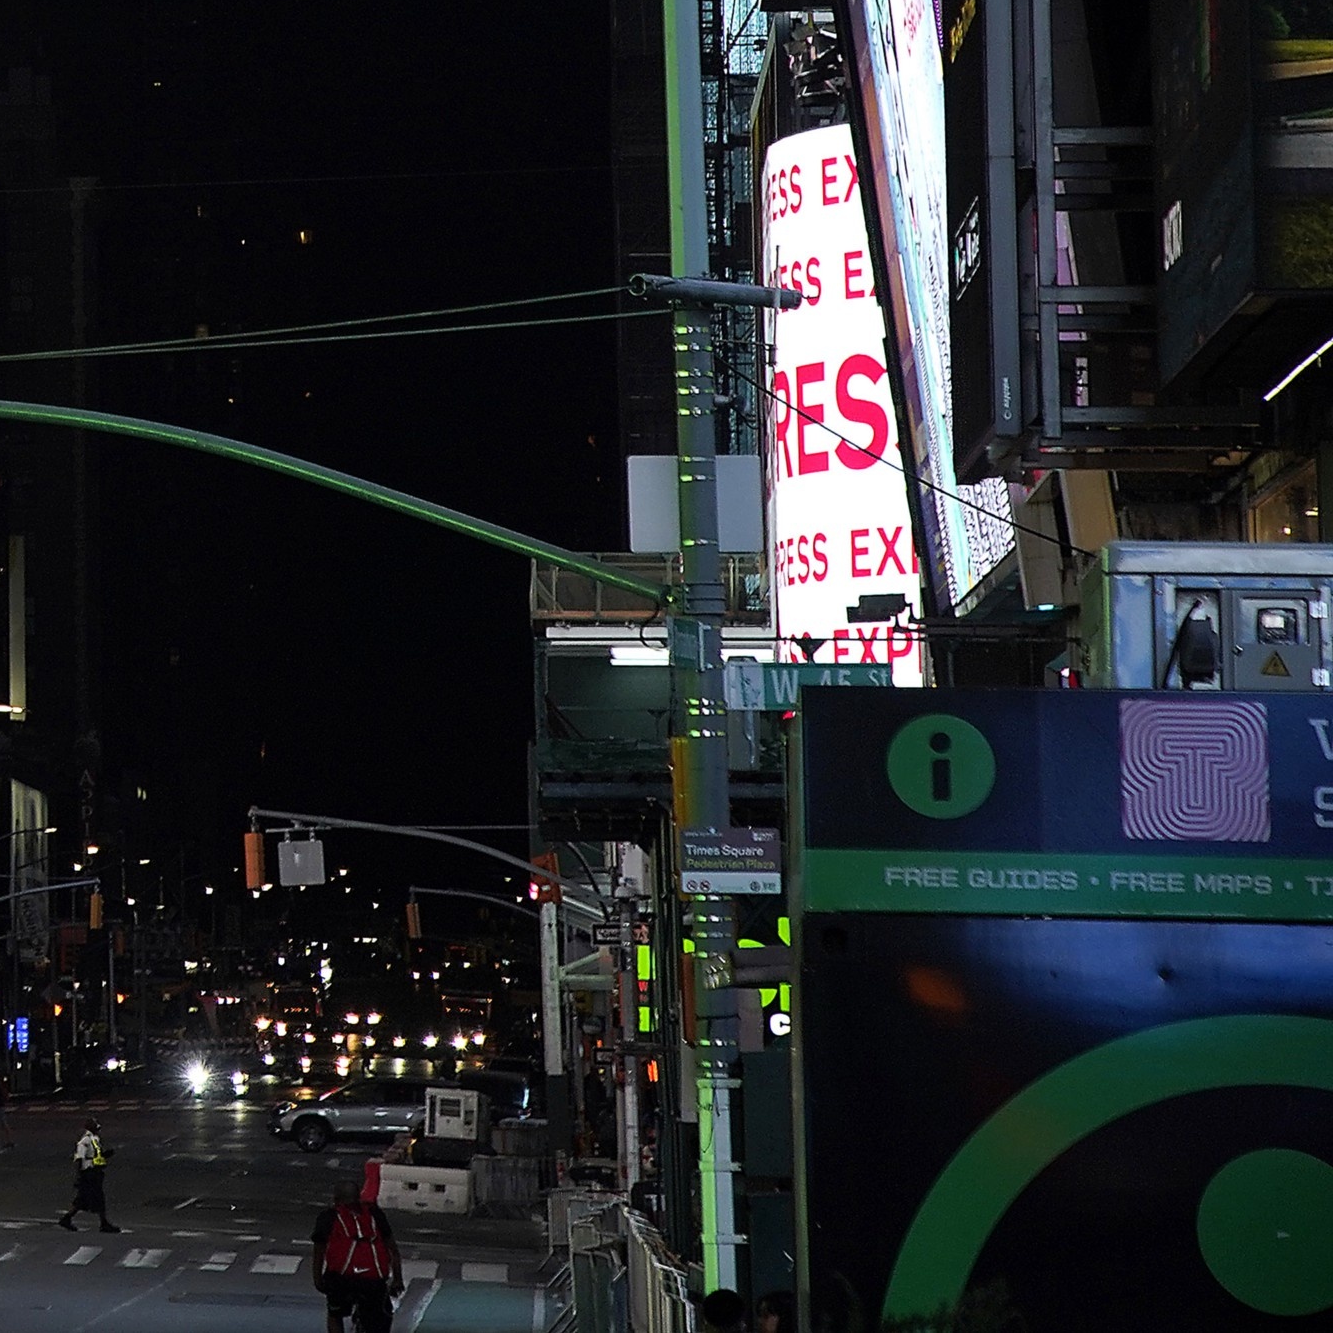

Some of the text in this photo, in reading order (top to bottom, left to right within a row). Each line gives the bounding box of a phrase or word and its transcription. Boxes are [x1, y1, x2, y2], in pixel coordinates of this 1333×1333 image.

[769, 164, 803, 223] ESS
[851, 526, 918, 578] EX
[771, 669, 799, 703] W
[685, 844, 764, 858] Times Square
[884, 866, 960, 890] FREE
[968, 867, 1079, 891] GUIDES
[1110, 868, 1186, 893] FREE
[1194, 873, 1273, 896] MAPS
